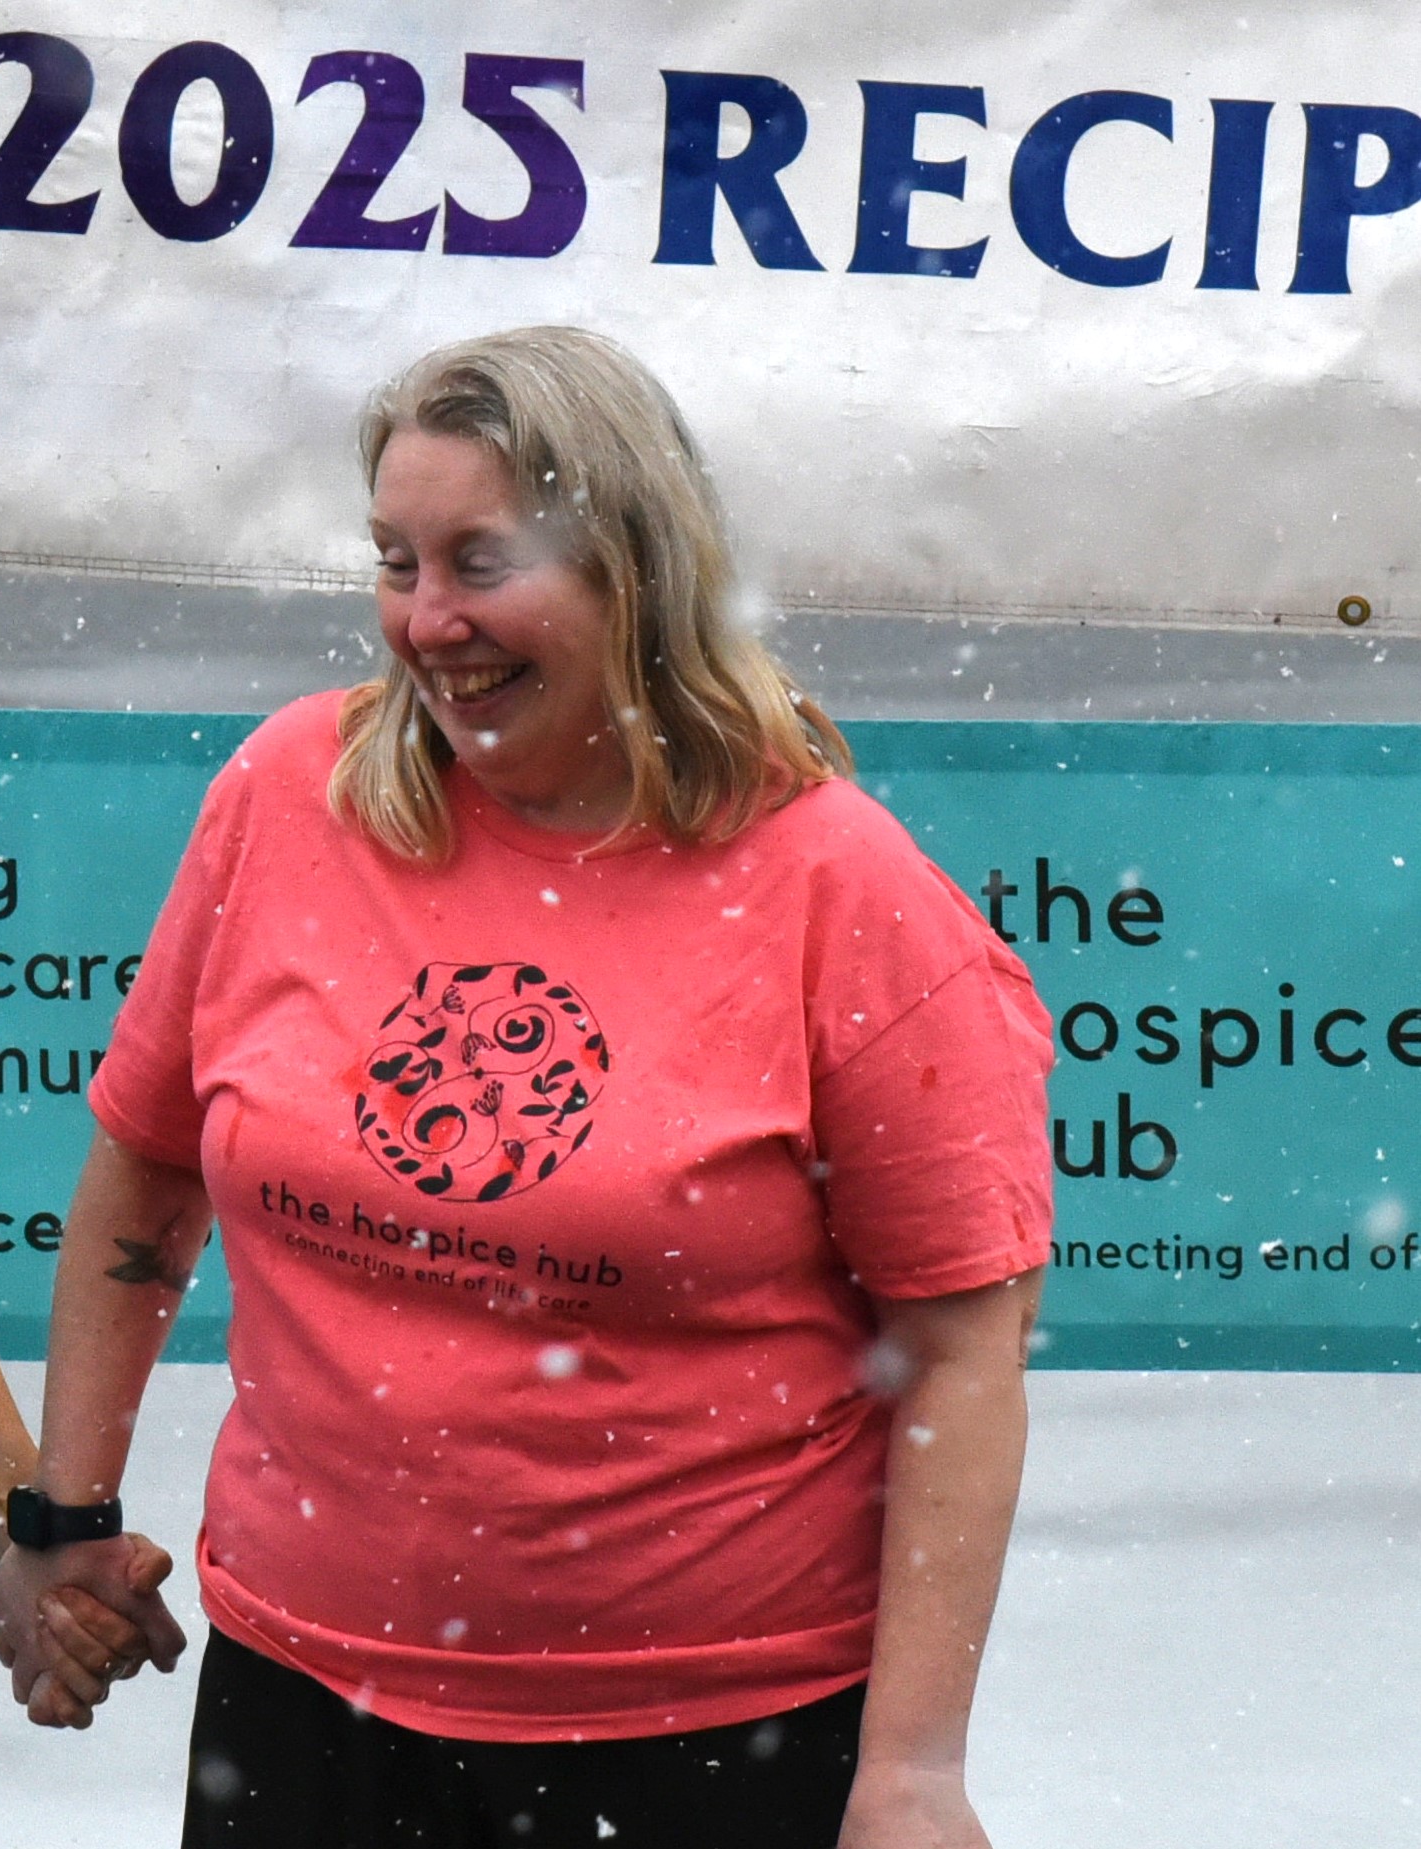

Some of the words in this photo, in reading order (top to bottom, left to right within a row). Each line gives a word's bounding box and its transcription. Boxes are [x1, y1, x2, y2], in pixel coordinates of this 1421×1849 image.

[651, 68, 1421, 295] RECIP
[981, 857, 1164, 946] the
[1053, 1092, 1178, 1181] ub
[260, 1180, 330, 1226] the
[353, 1202, 517, 1268] hospice
[537, 1243, 622, 1288] hub
[285, 1232, 405, 1281] connecting
[415, 1266, 455, 1287] end
[464, 1276, 487, 1292] of
[538, 1294, 590, 1312] care
[1264, 1234, 1350, 1271] end
[1370, 1232, 1419, 1271] of
